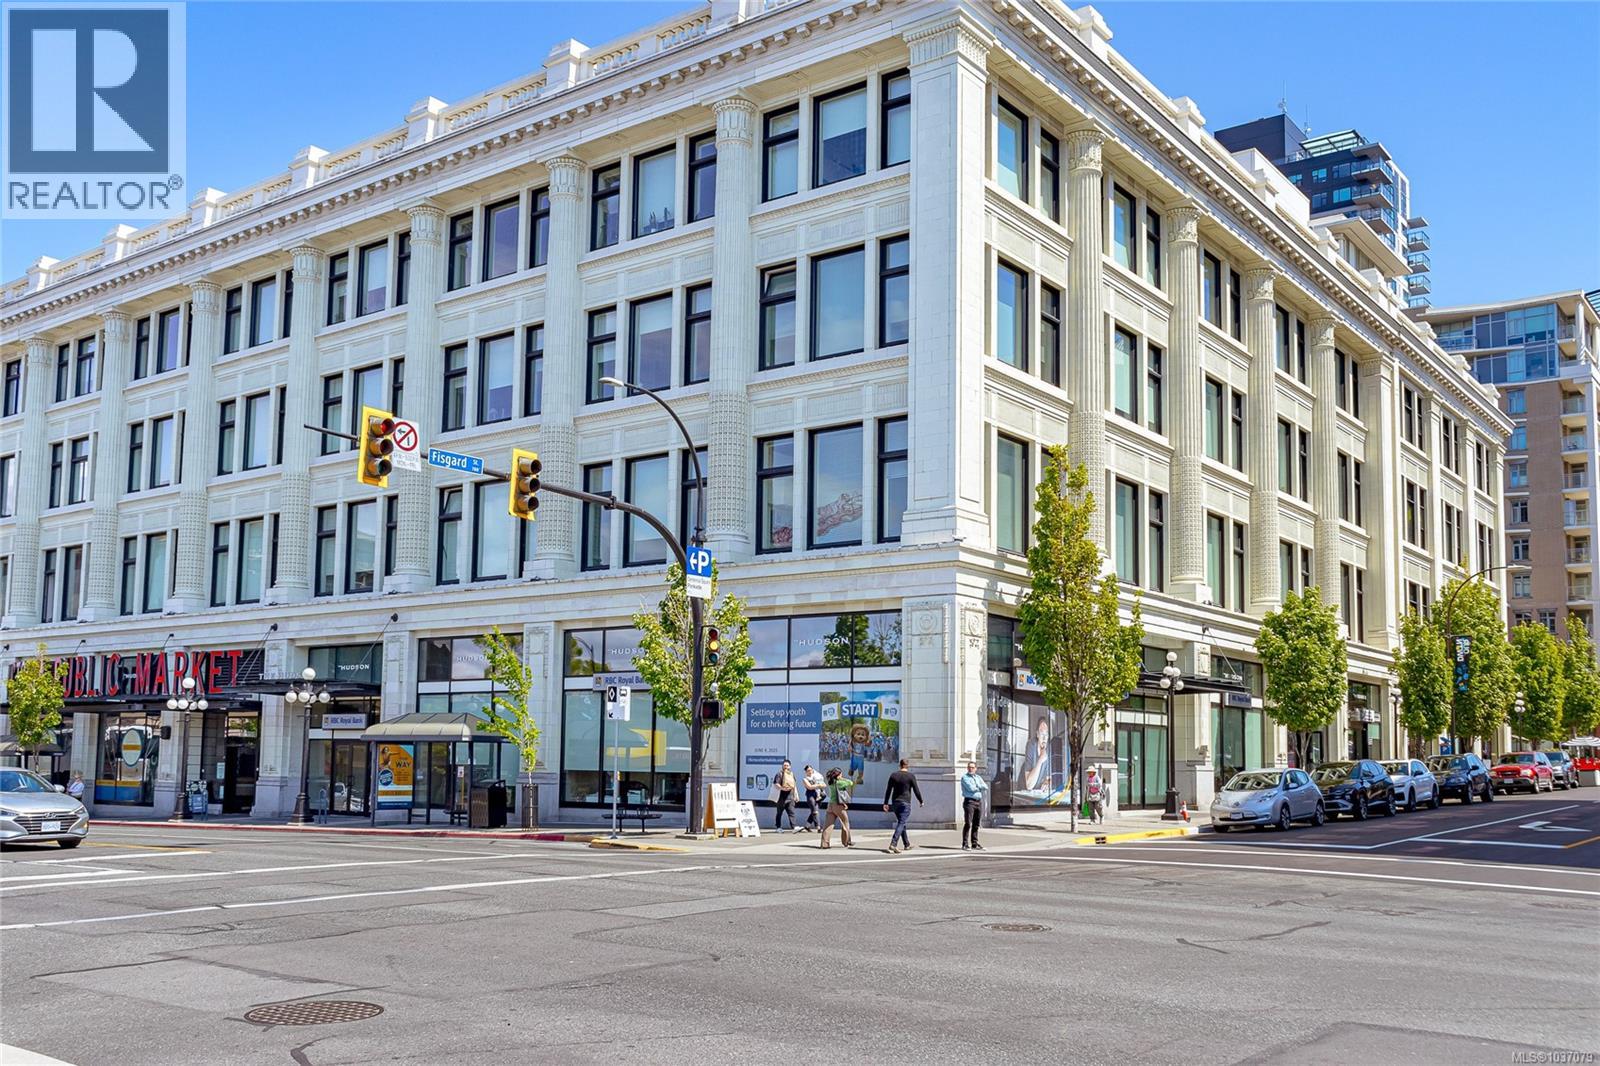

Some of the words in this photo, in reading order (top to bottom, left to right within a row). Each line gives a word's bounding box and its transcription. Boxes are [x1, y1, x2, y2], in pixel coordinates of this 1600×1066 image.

[432, 451, 467, 468] Fisgard
[698, 551, 709, 574] P
[799, 637, 849, 646] HUDSON
[612, 647, 645, 655] HUDSO
[134, 650, 243, 696] MARKET
[618, 675, 634, 686] Royal
[751, 708, 775, 719] Setting
[776, 710, 785, 719] up
[786, 708, 806, 718] youth
[842, 703, 877, 716] START
[750, 720, 760, 728] for
[767, 720, 794, 730] thriving
[795, 720, 816, 728] future
